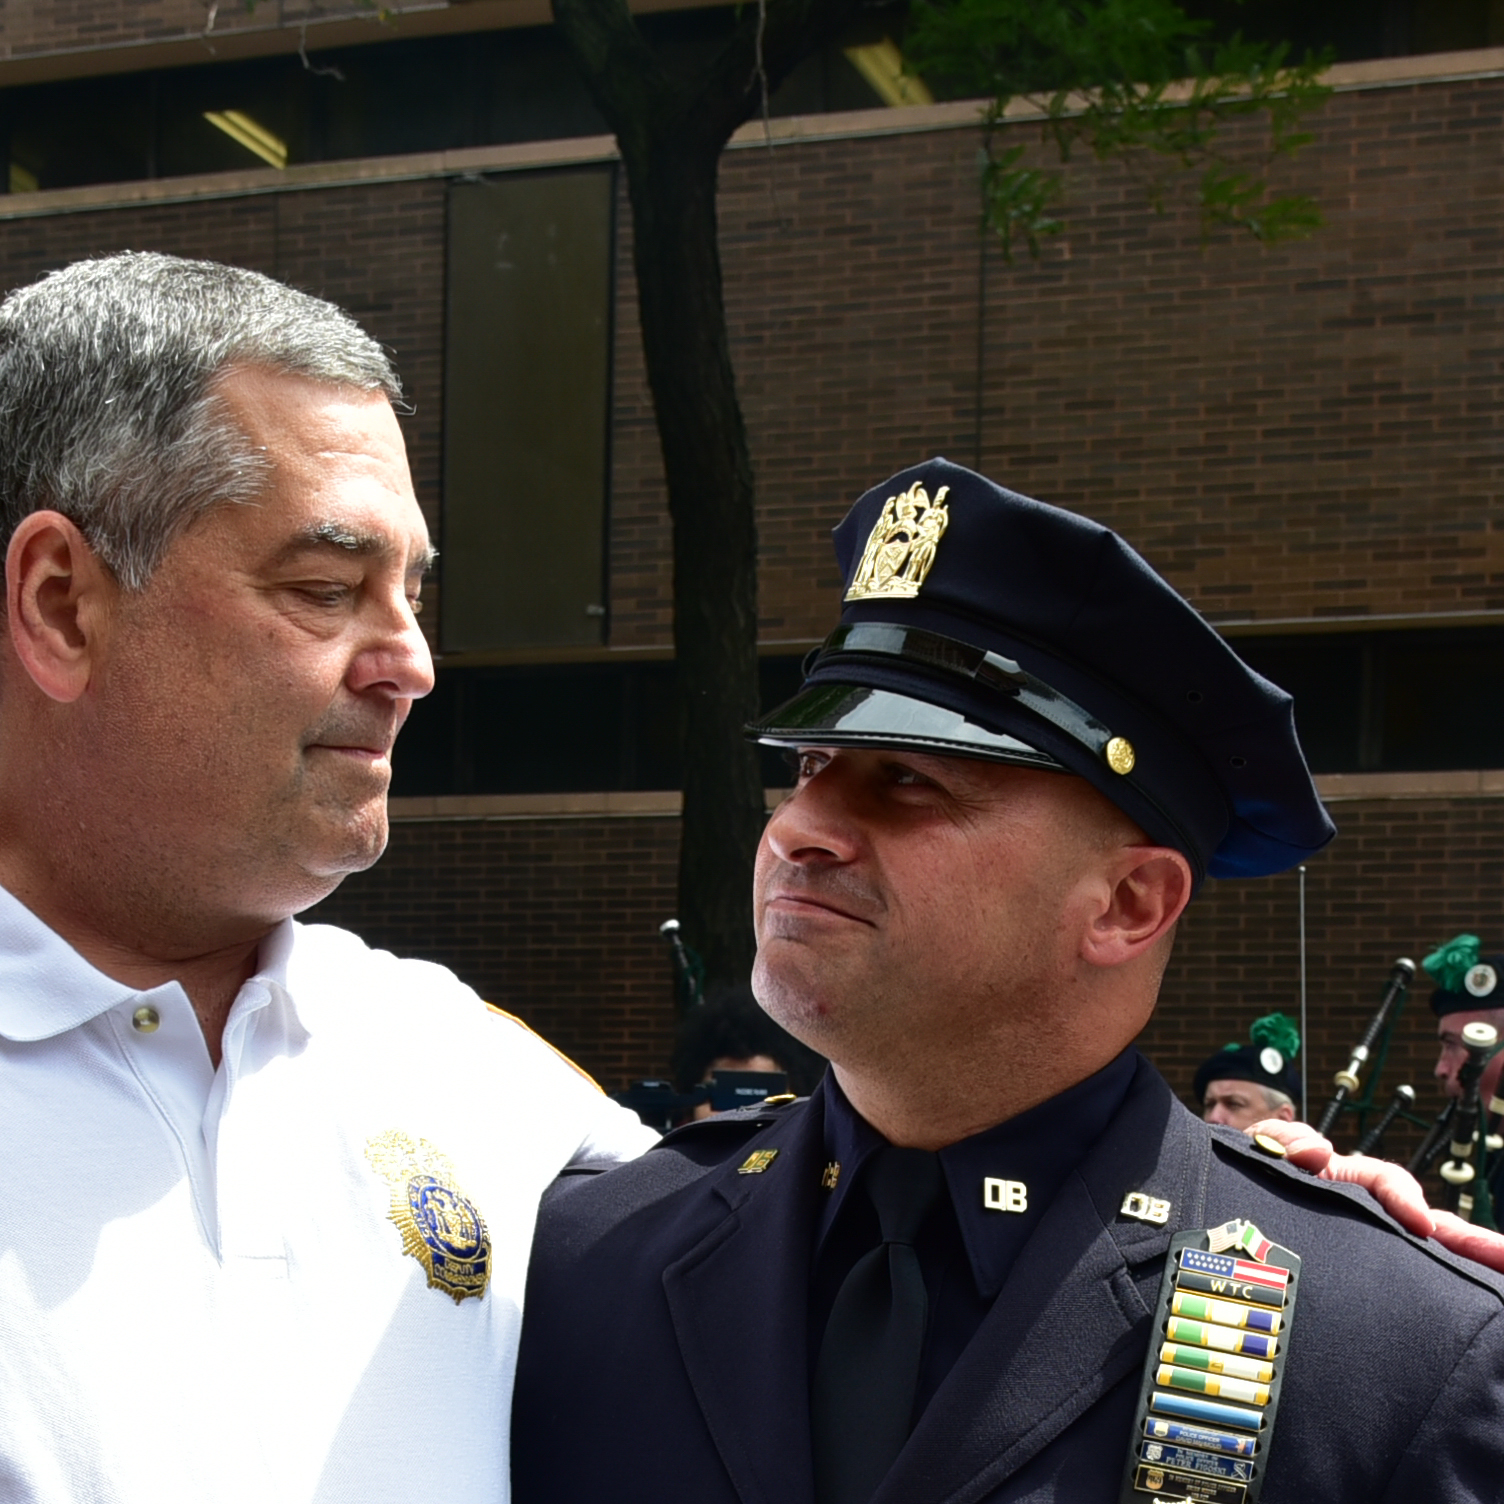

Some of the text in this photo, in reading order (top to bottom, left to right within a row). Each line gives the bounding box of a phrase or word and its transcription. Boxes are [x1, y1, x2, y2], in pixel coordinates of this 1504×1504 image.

[984, 1177, 1027, 1213] DB
[1120, 1191, 1171, 1226] DB
[1210, 1279, 1253, 1299] WTC
